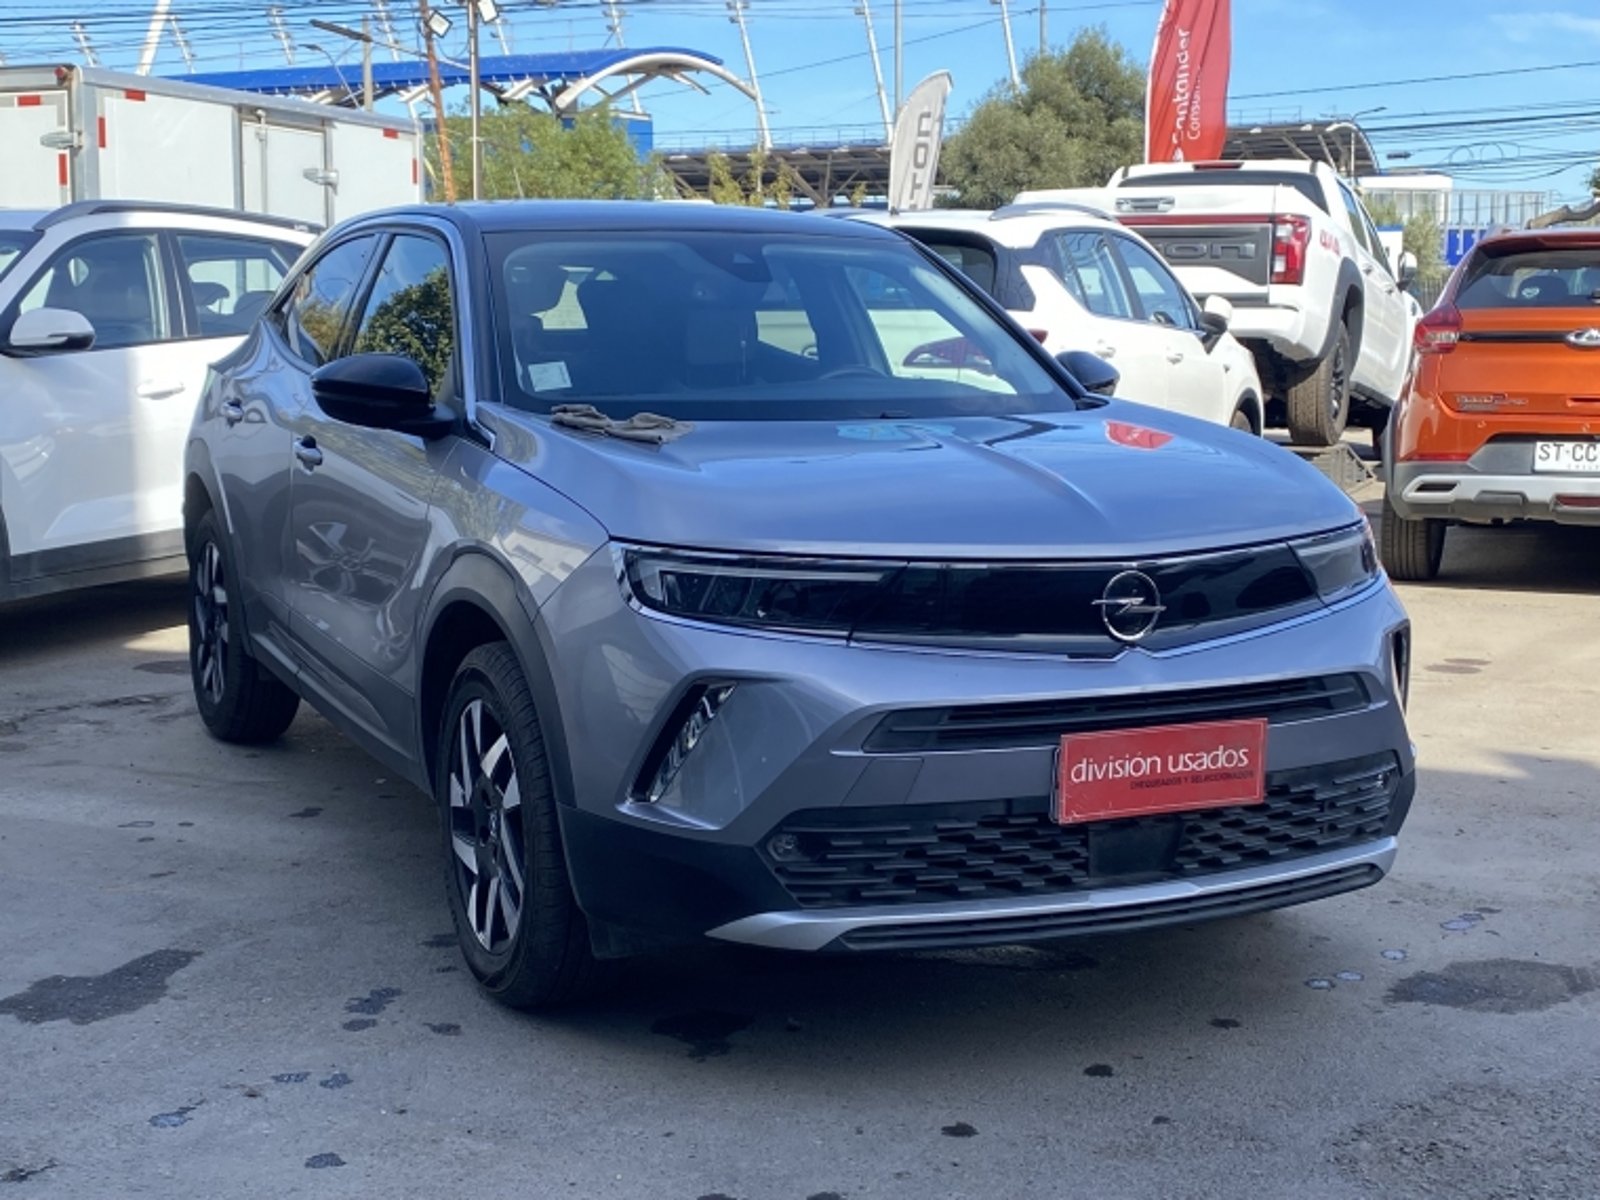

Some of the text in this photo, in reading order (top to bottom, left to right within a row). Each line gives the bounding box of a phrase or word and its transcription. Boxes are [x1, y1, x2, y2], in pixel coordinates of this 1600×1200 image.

[1172, 28, 1190, 144] Santander
[1070, 745, 1249, 783] división usados
